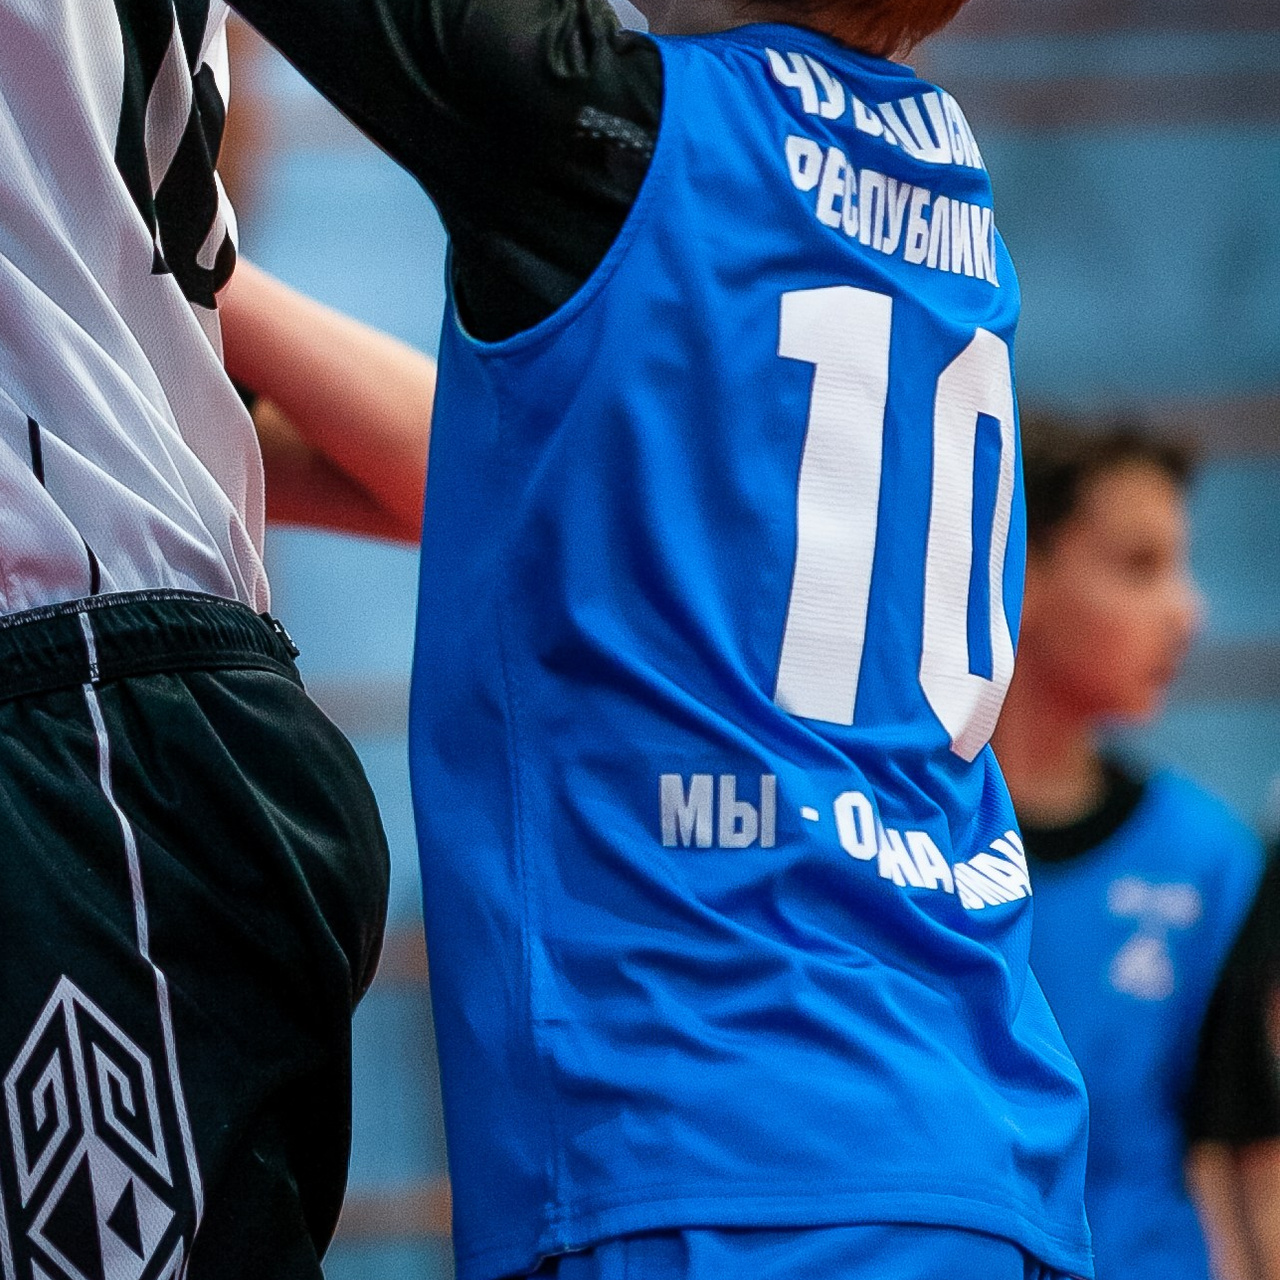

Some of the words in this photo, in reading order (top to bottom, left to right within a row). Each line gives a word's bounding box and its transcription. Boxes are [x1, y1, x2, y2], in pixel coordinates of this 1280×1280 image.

[785, 134, 1000, 289] РЕСПУБЛИК
[774, 285, 1017, 763] 10
[658, 773, 777, 848] МЫ
[833, 790, 954, 894] ОНА
